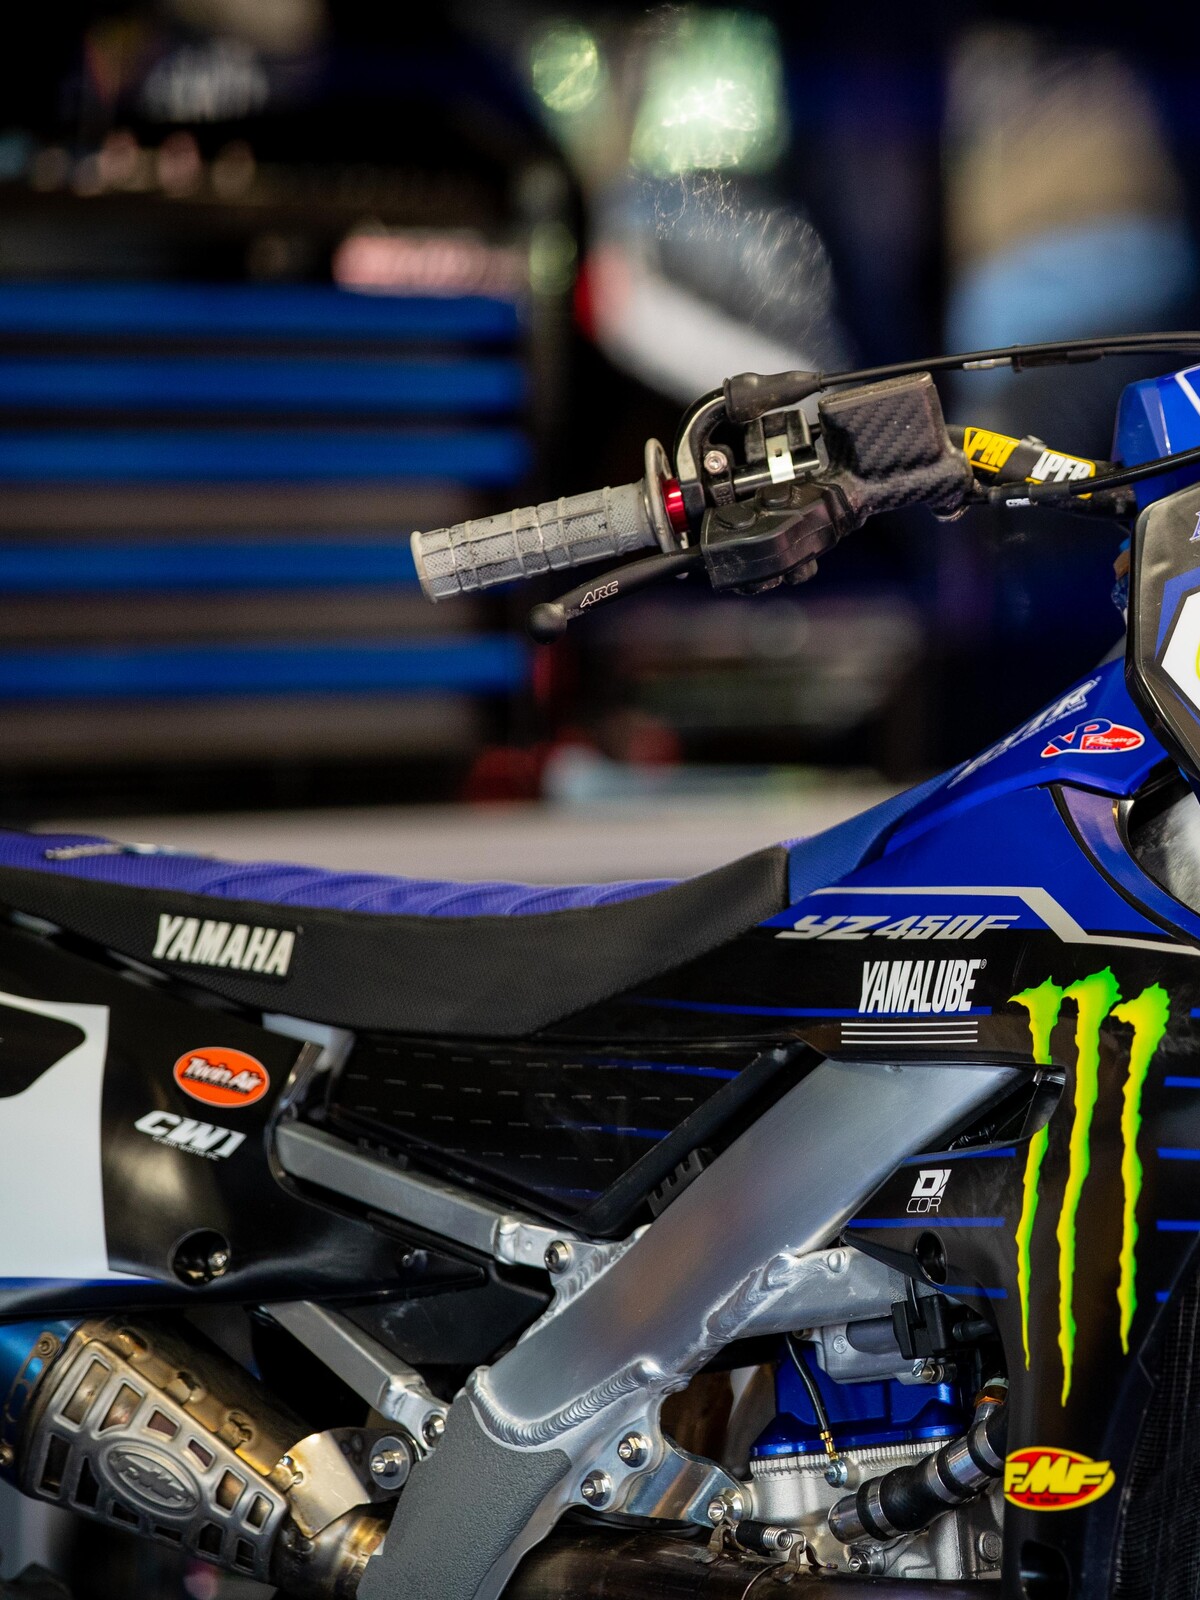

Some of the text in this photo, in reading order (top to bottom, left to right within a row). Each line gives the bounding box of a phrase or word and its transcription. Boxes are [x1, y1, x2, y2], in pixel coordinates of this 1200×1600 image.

[579, 580, 619, 608] ARC
[153, 913, 297, 977] YAMAHA
[773, 915, 1021, 940] YZ450F
[858, 959, 982, 1013] YAMALUBE
[183, 1056, 234, 1084] Twin
[228, 1069, 263, 1093] Air
[1004, 1455, 1111, 1494] FMF
